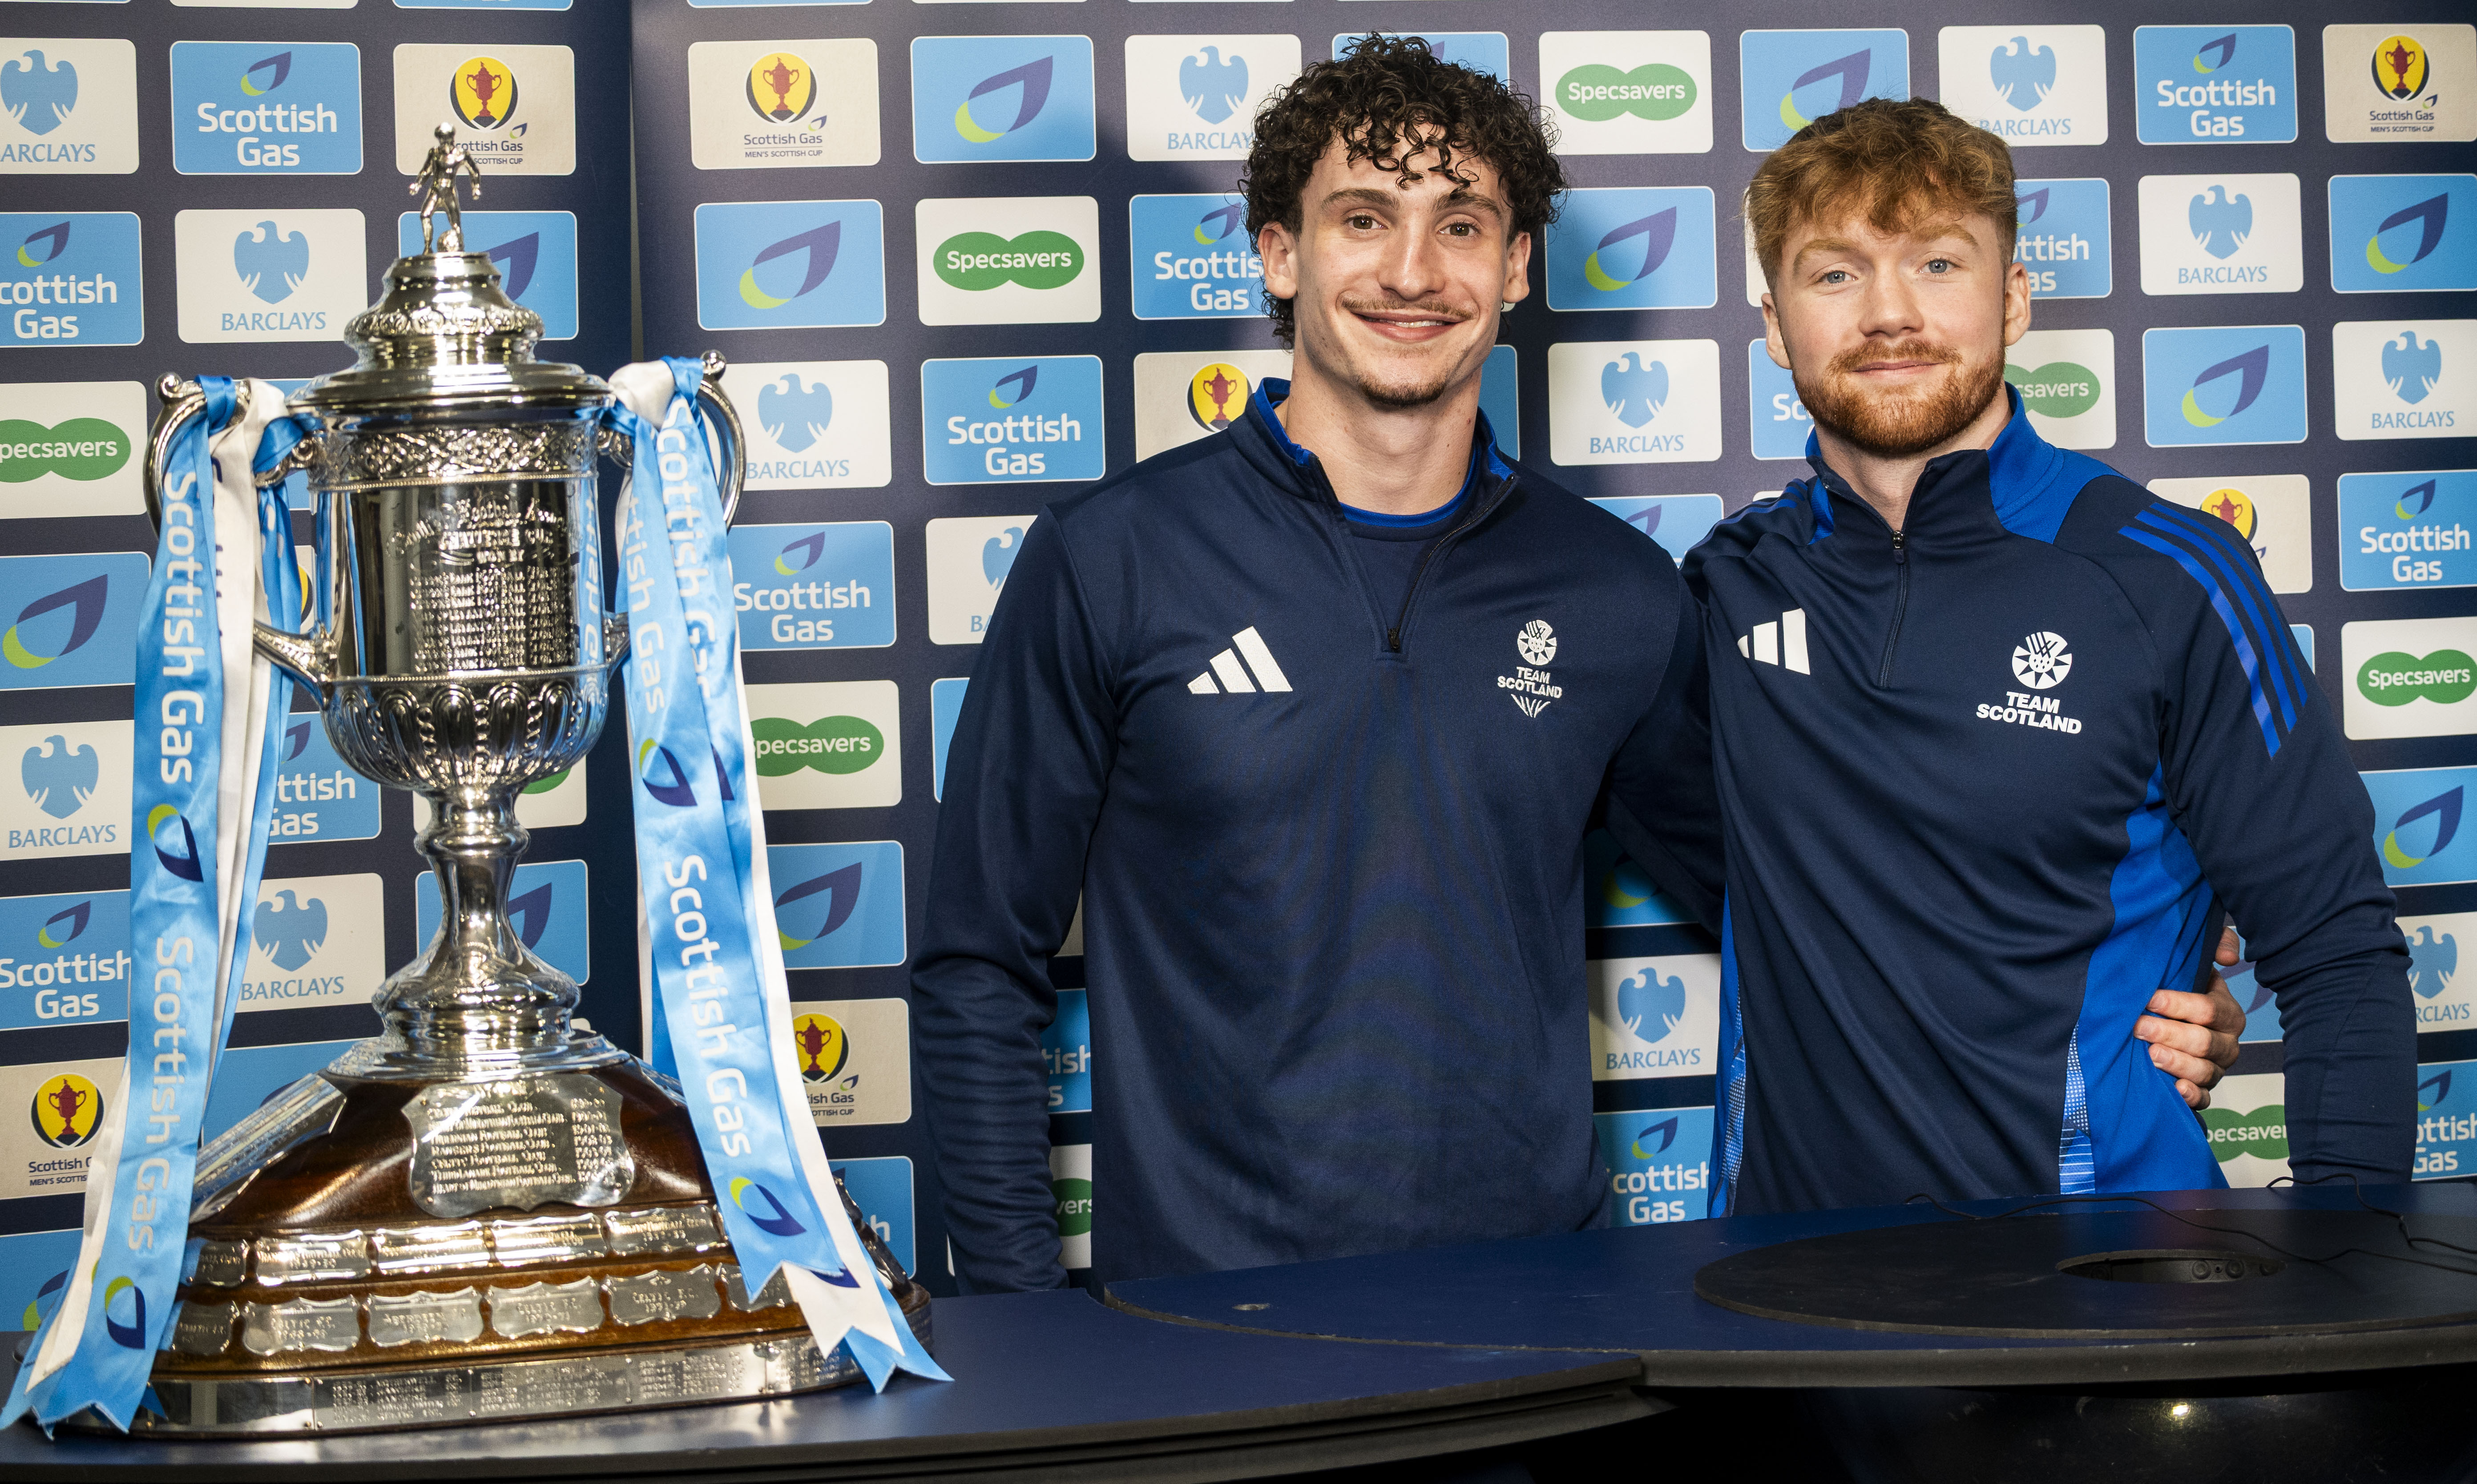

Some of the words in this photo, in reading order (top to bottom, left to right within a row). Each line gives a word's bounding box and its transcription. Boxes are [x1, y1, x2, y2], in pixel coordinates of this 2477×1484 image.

[1568, 82, 1685, 104] Specsavers
[2157, 79, 2275, 107] Scottish
[198, 103, 337, 133] Scottish
[2191, 110, 2244, 137] Gas
[2369, 110, 2412, 121] Scottish
[2416, 111, 2434, 121] Gas
[238, 137, 300, 166] Gas
[455, 140, 497, 152] cottish
[500, 141, 523, 152] Gas
[744, 133, 796, 145] Scottish
[799, 133, 823, 145] Gas
[1167, 132, 1255, 150] BARCLAY
[0, 143, 96, 163] ARCLAYS
[2013, 233, 2089, 262] ttish
[947, 251, 1072, 272] Specsavers
[1155, 252, 1264, 280] Scottis
[2030, 270, 2057, 292] as
[2178, 266, 2267, 285] BARCLAYS
[0, 274, 117, 305] cottish
[1191, 283, 1249, 311] Gas
[14, 310, 78, 339] Gas
[222, 312, 327, 331] BARCLAYS
[948, 414, 1081, 445] Scottish
[2371, 411, 2454, 429] BARCLAYS
[0, 440, 117, 463] pecsavers
[1589, 435, 1684, 454] BARCLAYS
[745, 460, 849, 479] BARCLAYS
[985, 448, 1045, 476] Gas
[657, 398, 709, 597] Scottish
[2360, 524, 2470, 554] Scottish
[162, 472, 205, 677] Scottish
[2392, 556, 2442, 582] Gas
[734, 580, 870, 611] Scottish
[771, 614, 834, 642] Gas
[636, 621, 665, 714] Gas
[1517, 666, 1550, 684] TEAM
[2368, 668, 2471, 690] Specsavers
[1497, 675, 1562, 699] SCOTLAND
[2006, 691, 2060, 714] TEAM
[1976, 703, 2082, 734] SCOTLAND
[161, 690, 204, 784] Gas
[753, 735, 871, 758] pecsavers
[277, 770, 355, 802] ttish
[9, 824, 116, 849] BARCLAYS
[241, 976, 344, 1001] BARCLAYS
[35, 989, 99, 1020] Gas
[665, 855, 737, 1057] Scottish
[706, 1068, 752, 1157] Gas
[2416, 1003, 2470, 1023] RCLAYS
[146, 937, 194, 1144] Scottish
[1606, 1048, 1700, 1070] BARCLAYS
[831, 1092, 854, 1103] Gas
[2416, 1112, 2477, 1142] ottish
[28, 1159, 83, 1173] Scottish
[1606, 1161, 1709, 1194] cottish
[29, 1177, 54, 1186] MEN'S
[56, 1175, 87, 1185] SCOTTIS
[129, 1157, 170, 1251] Gas
[1628, 1197, 1685, 1223] Gas
